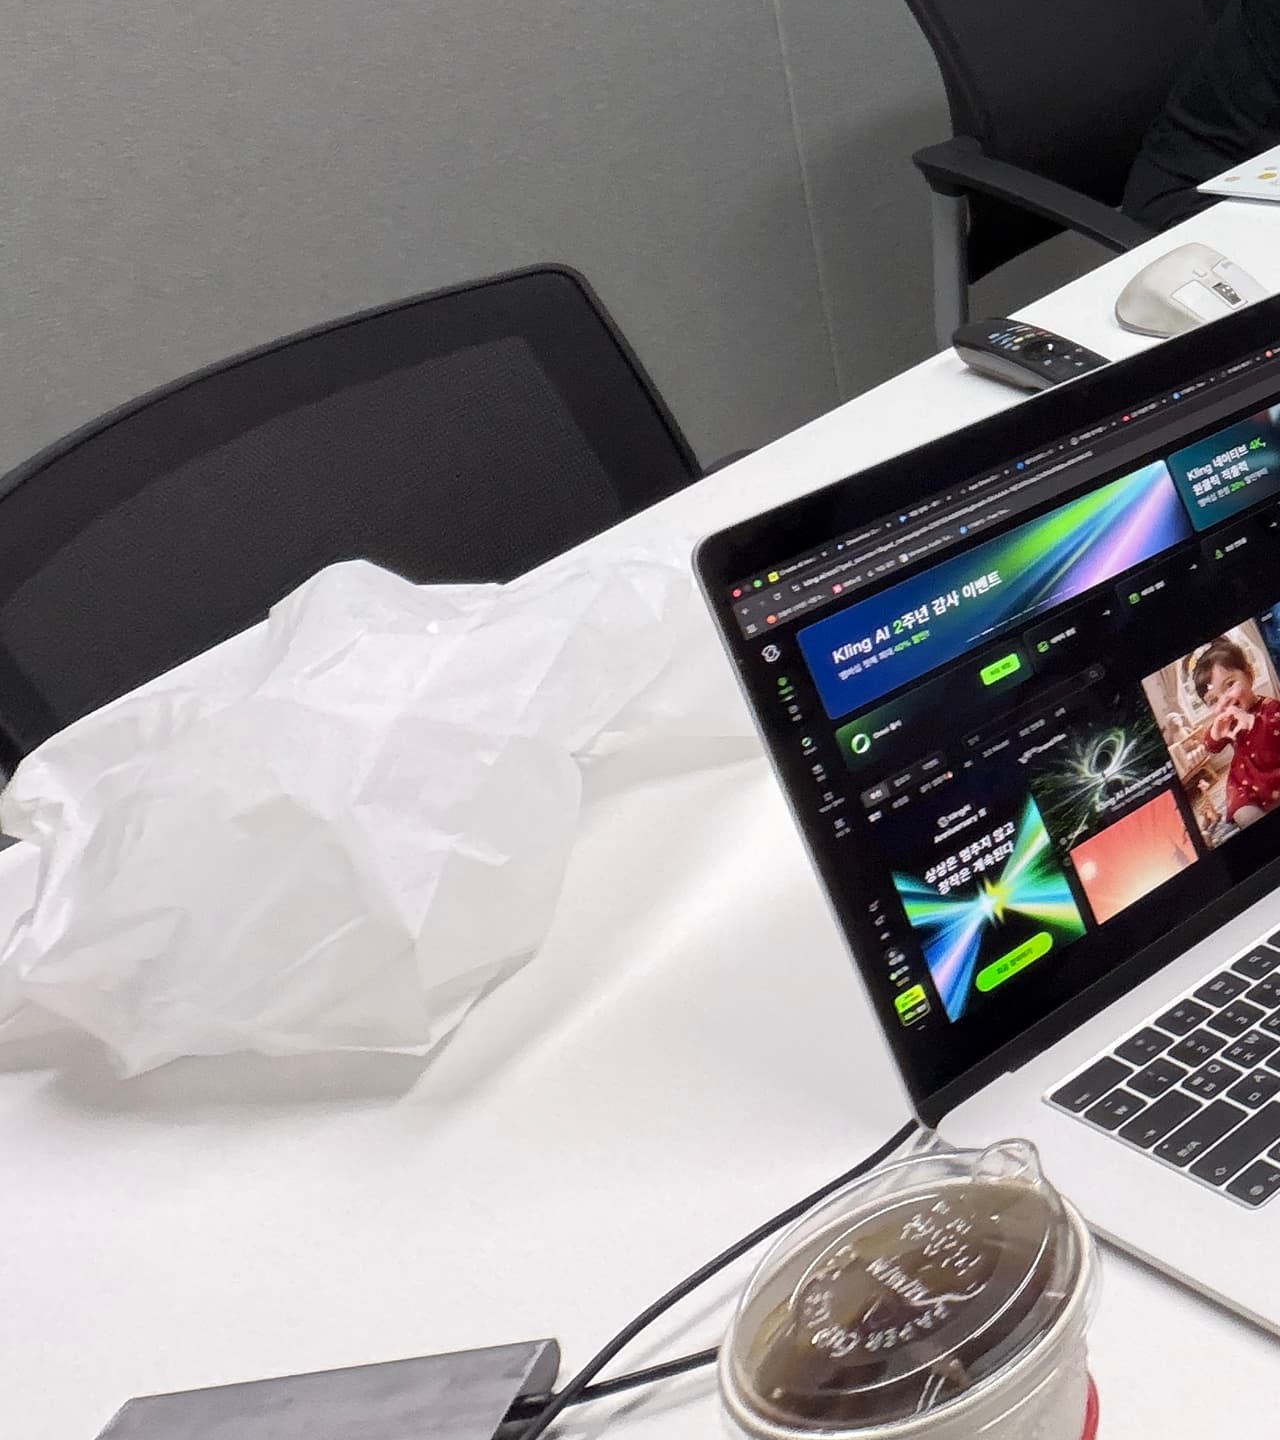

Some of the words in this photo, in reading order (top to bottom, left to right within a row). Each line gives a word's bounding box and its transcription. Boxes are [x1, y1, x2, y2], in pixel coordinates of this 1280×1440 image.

[1186, 464, 1213, 482] Kling
[831, 636, 872, 664] Kling
[875, 626, 890, 645] AI
[893, 607, 930, 635] 2주년
[931, 591, 960, 615] 감사
[962, 570, 1002, 598] 이벤트
[925, 856, 958, 884] 상상은
[959, 837, 993, 862] 멈추지
